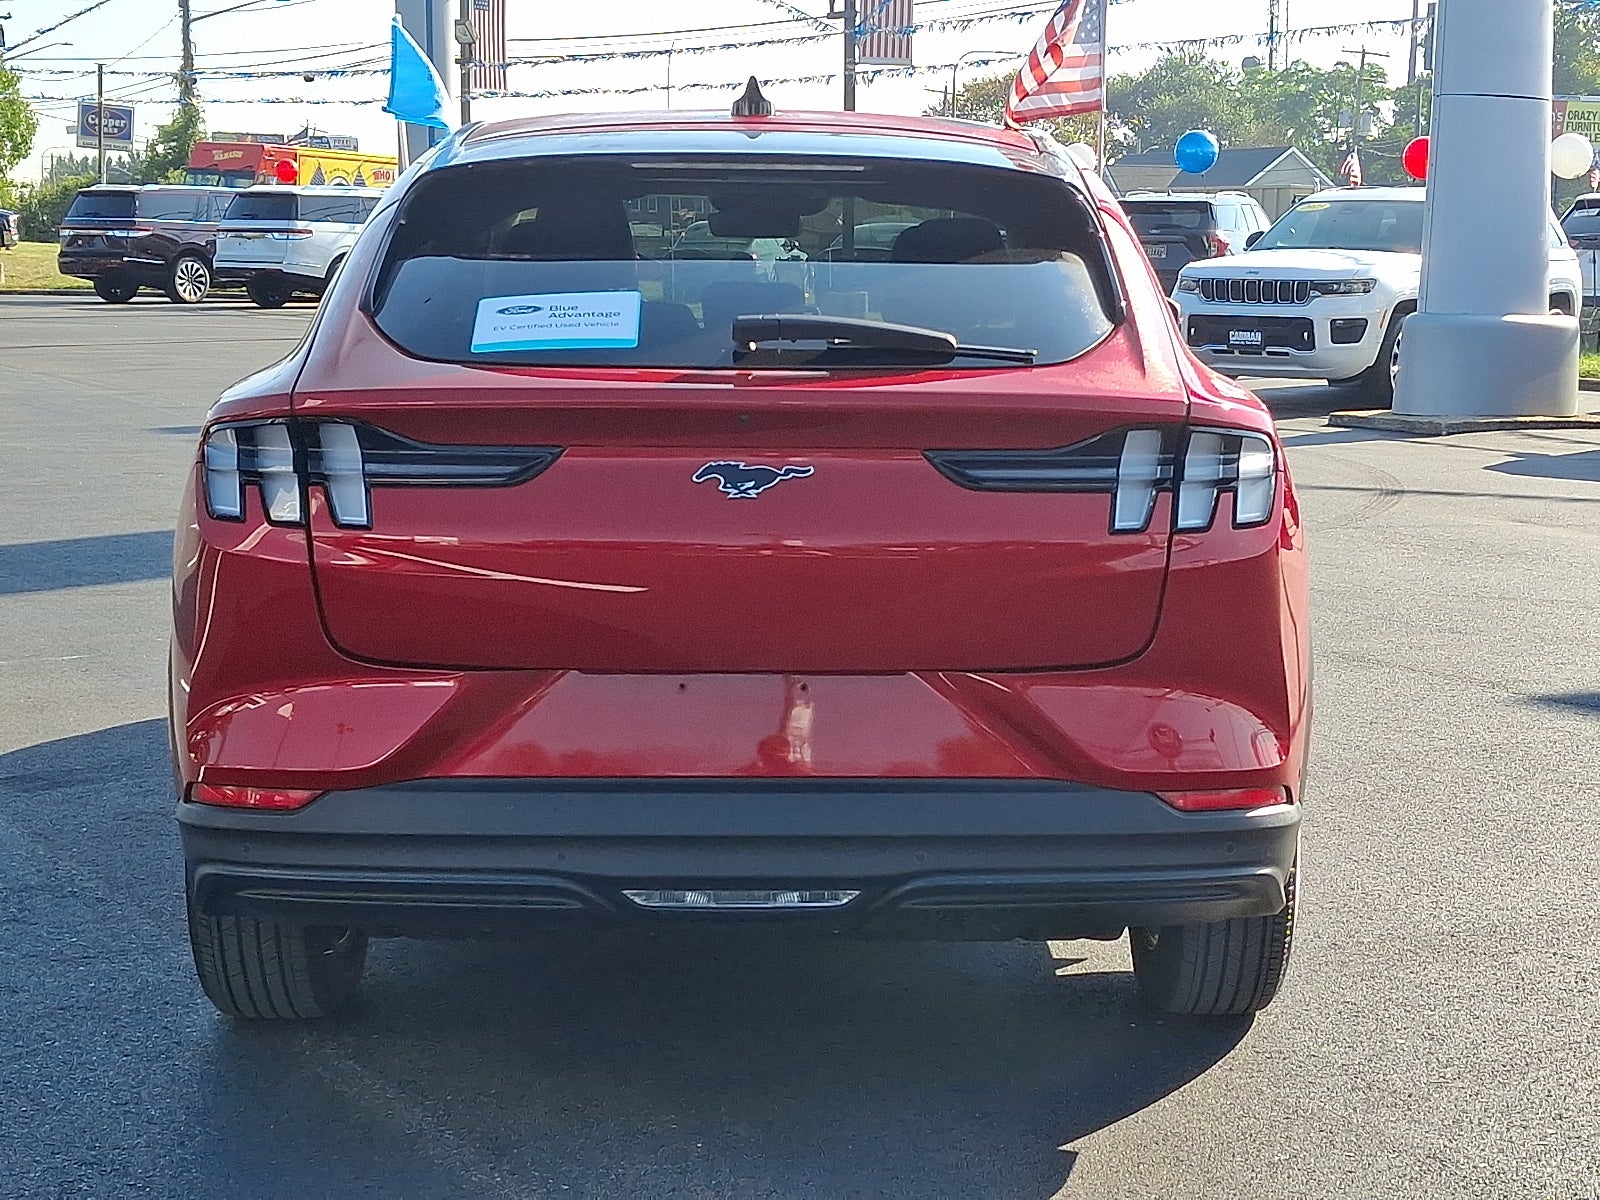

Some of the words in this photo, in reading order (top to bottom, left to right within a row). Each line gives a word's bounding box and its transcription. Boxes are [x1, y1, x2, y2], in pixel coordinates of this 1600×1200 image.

[1567, 110, 1598, 121] CRAZY
[549, 304, 579, 312] Blue
[548, 311, 621, 319] Advantage
